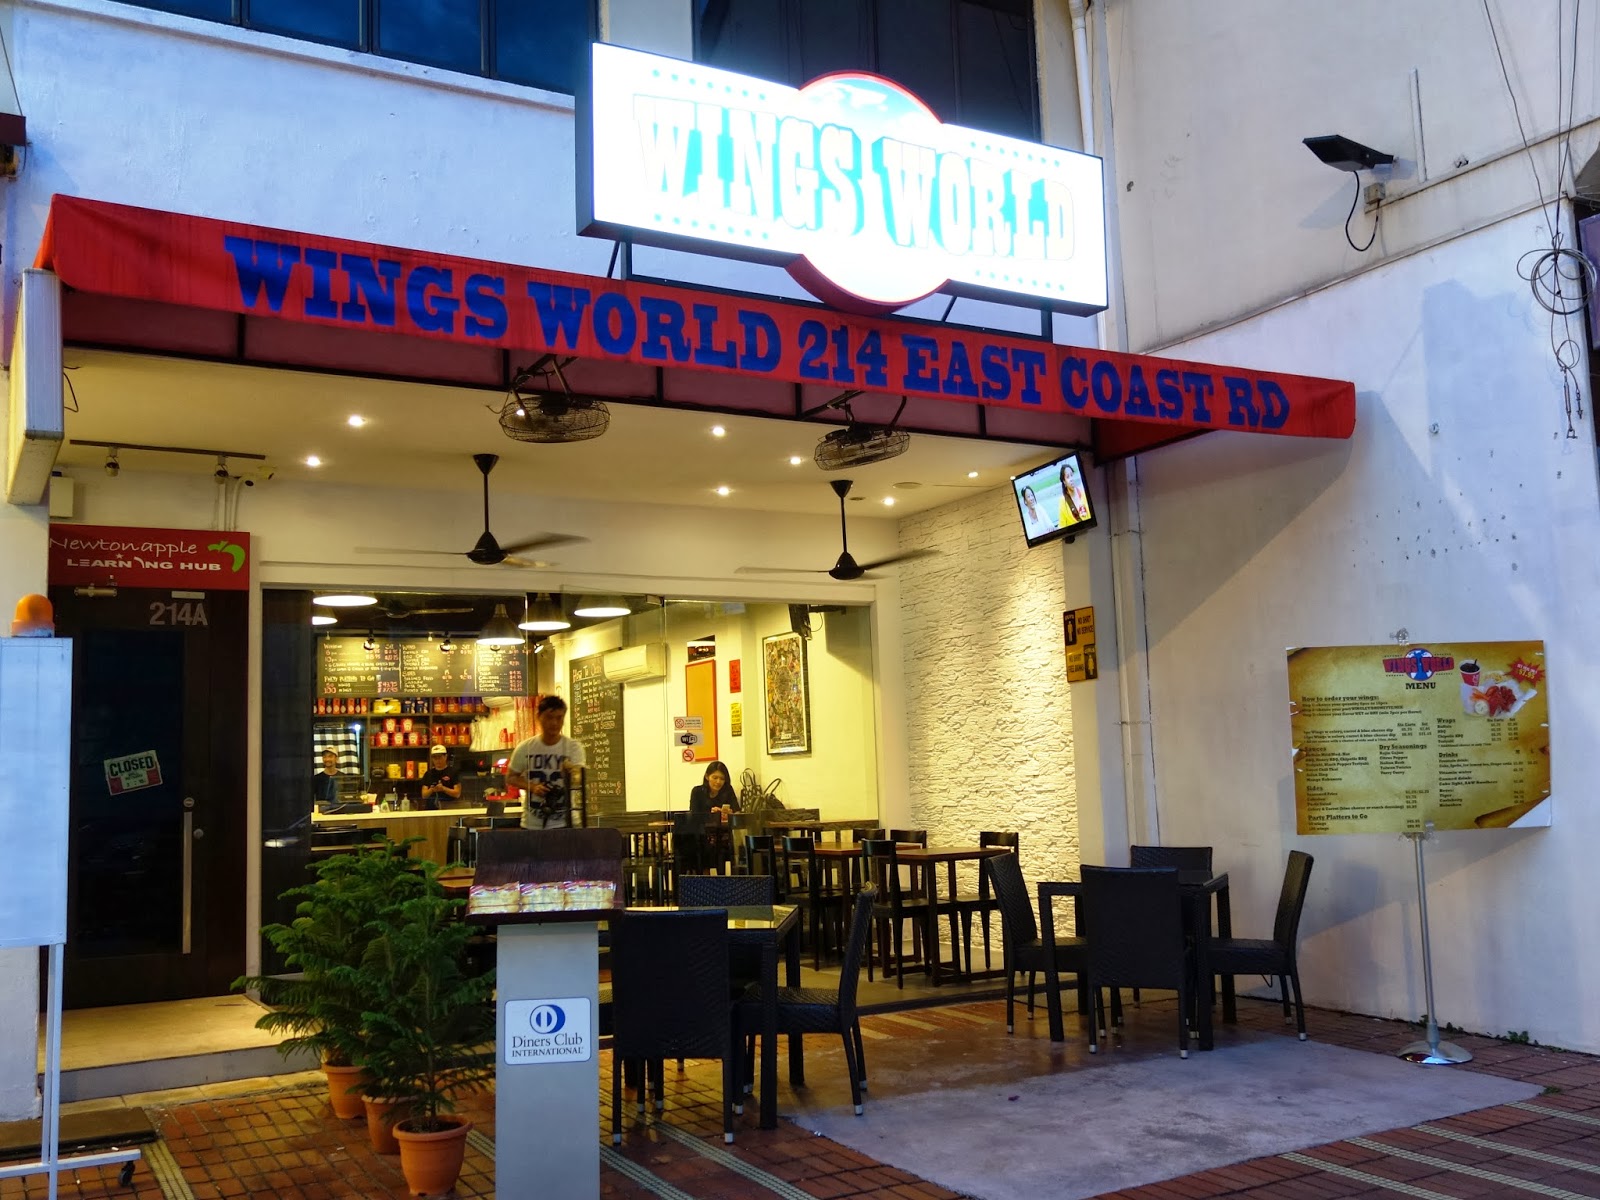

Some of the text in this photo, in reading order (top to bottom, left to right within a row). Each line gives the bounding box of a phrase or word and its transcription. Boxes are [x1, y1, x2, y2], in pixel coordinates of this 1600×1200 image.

[633, 93, 1075, 260] WINGS WORLD
[224, 234, 1290, 430] WINGS WORLD 214 EAST COAST RD
[180, 562, 222, 571] HUB
[150, 601, 208, 626] 214A
[1405, 682, 1436, 690] MENU
[110, 756, 154, 776] CLOSED
[526, 754, 570, 770] TOKY
[512, 1032, 583, 1048] Diners Club
[512, 1047, 583, 1057] INTERNATIONAL
